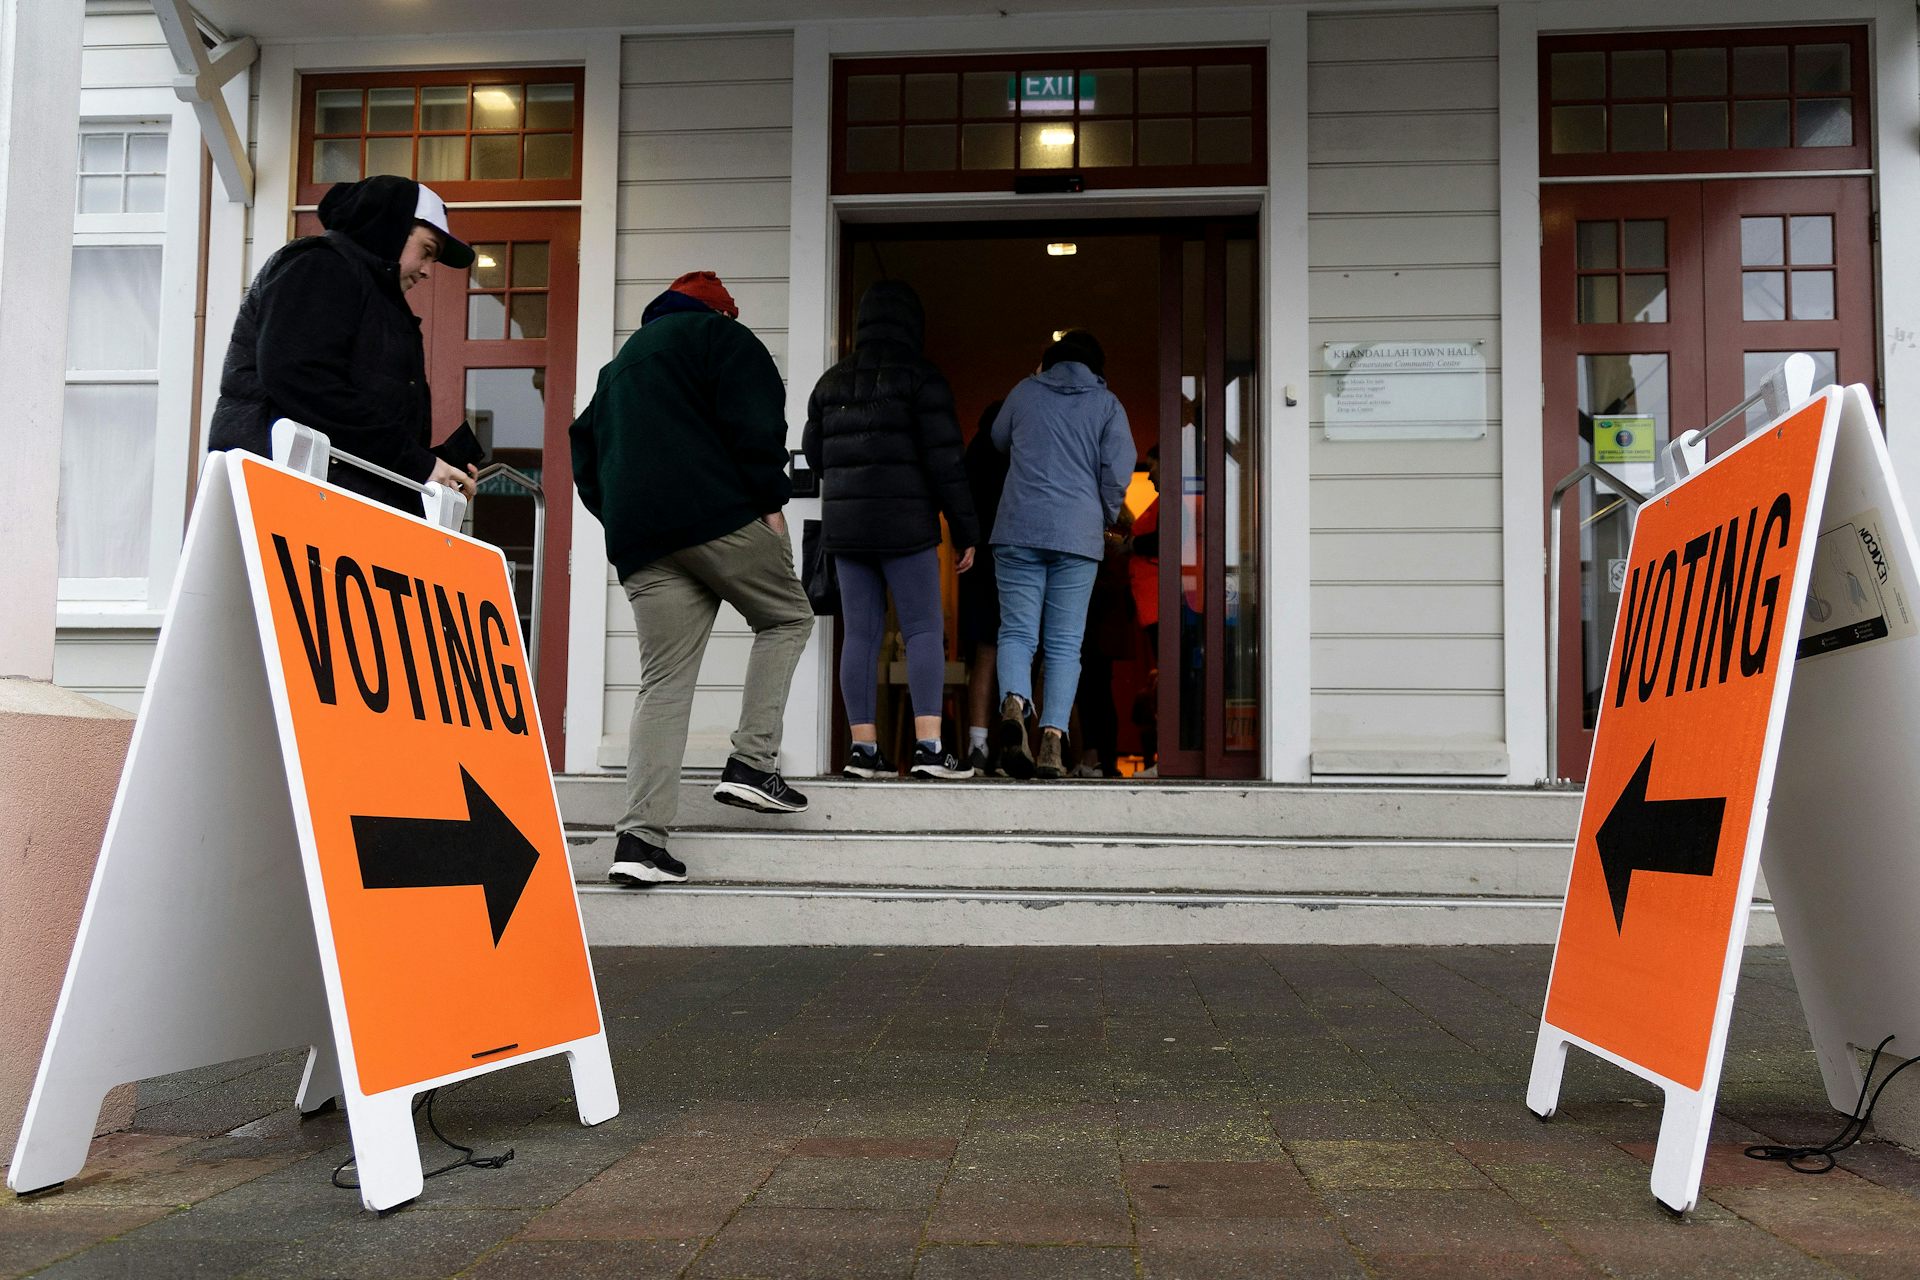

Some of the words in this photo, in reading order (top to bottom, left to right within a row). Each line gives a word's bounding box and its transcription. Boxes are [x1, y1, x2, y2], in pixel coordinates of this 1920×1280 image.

[1333, 348, 1409, 359] KHANDALLAH
[1412, 348, 1445, 357] TOWN
[1447, 347, 1477, 356] HALL
[1394, 360, 1435, 369] Community
[1858, 527, 1888, 585] LEXICON
[1615, 492, 1791, 709] VOTING
[271, 533, 529, 736] VOTING
